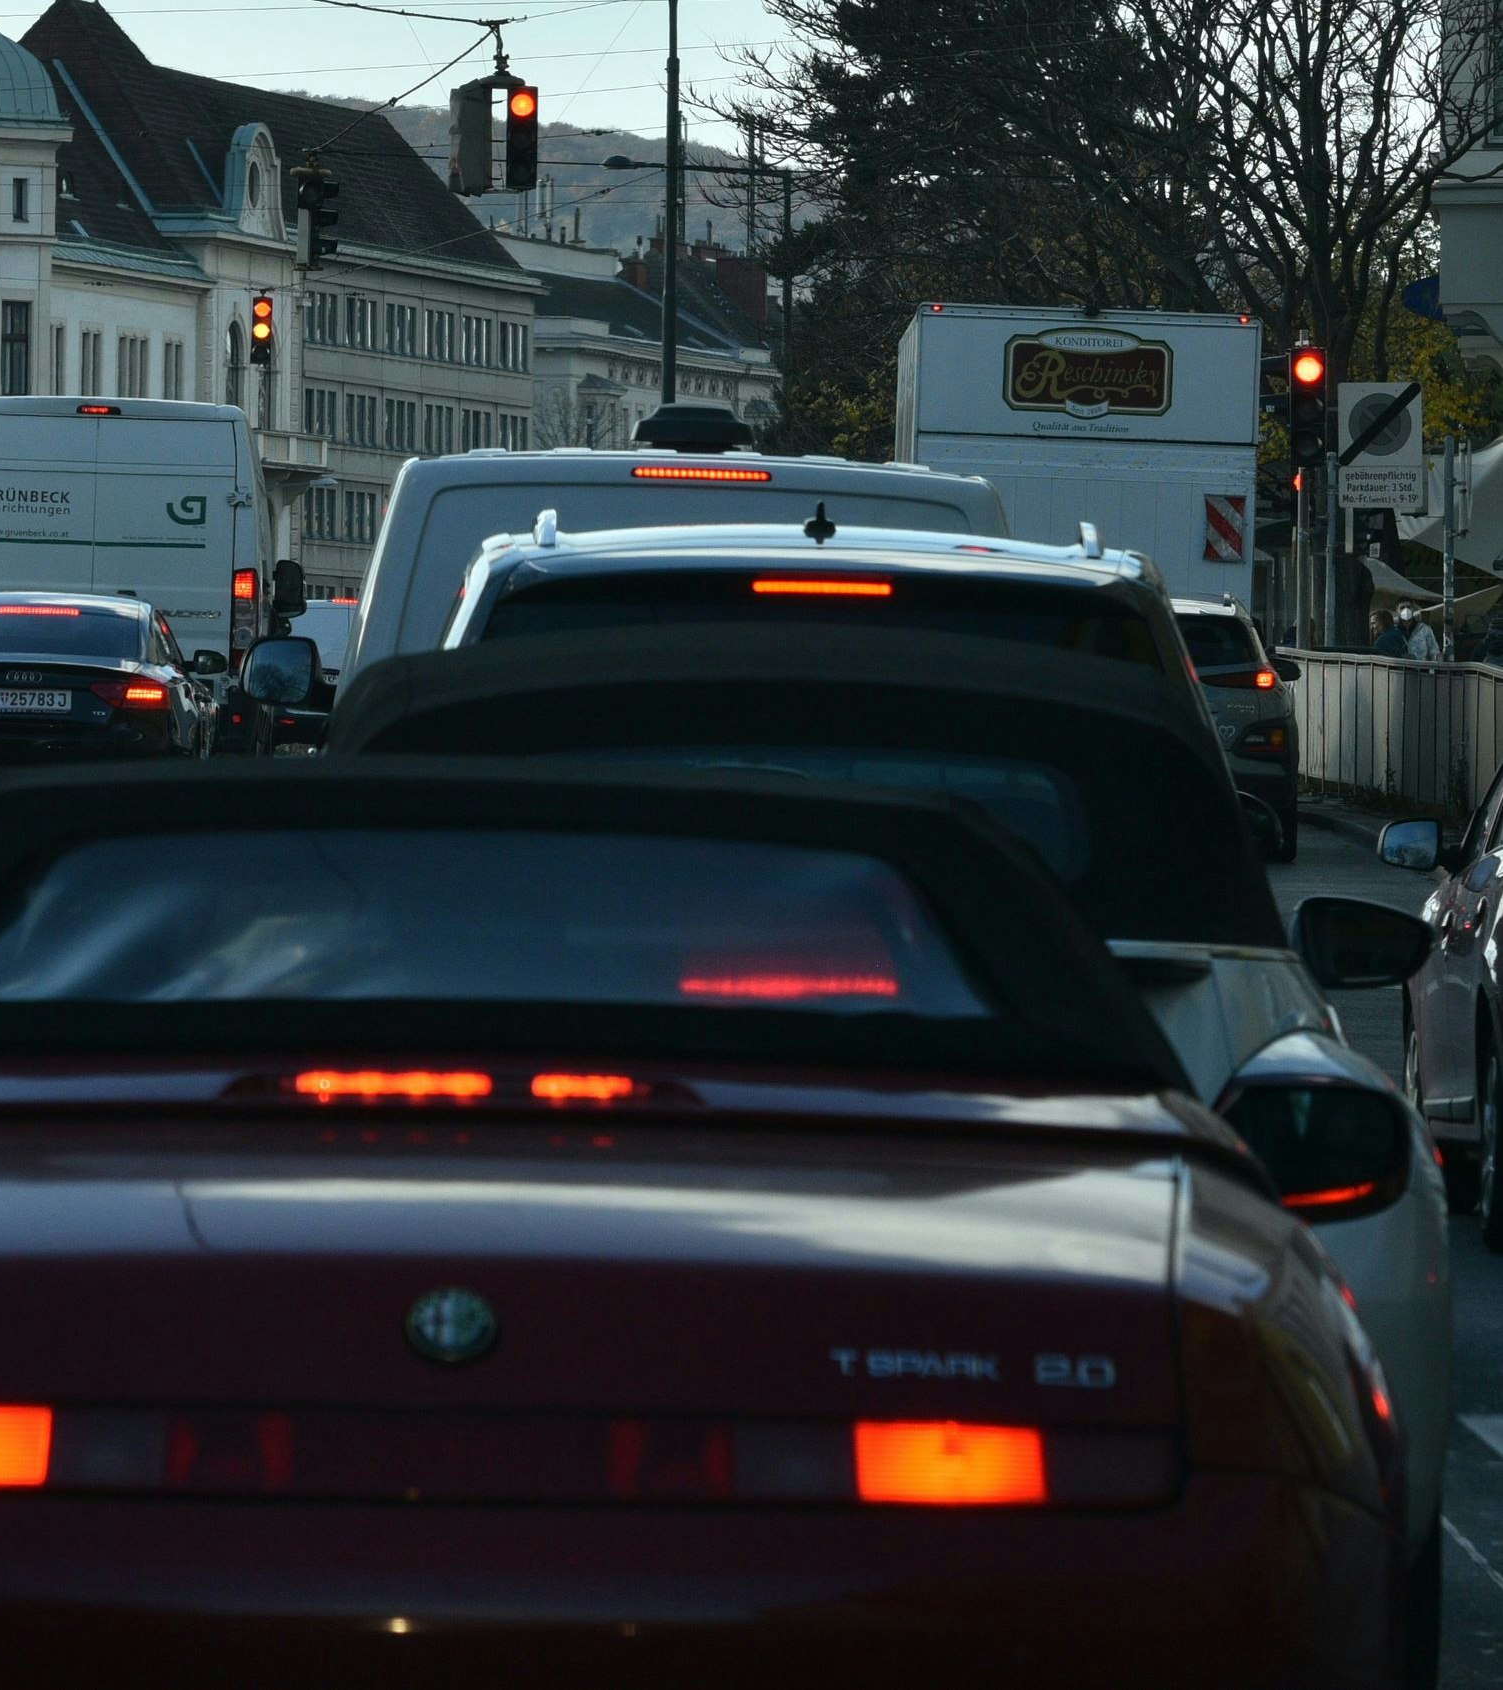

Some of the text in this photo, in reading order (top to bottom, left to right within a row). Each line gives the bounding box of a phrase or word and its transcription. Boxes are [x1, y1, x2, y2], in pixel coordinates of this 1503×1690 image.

[1055, 337, 1123, 348] KONDITOREI
[1015, 350, 1160, 399] Reschinsky
[1032, 421, 1129, 433] Qualität aus Tradition
[1345, 471, 1417, 481] gebührenpflichtig
[1347, 483, 1390, 492] Parkdauer:
[1399, 483, 1415, 492] Std.
[829, 1347, 859, 1377] T
[866, 1350, 1000, 1380] SPARK
